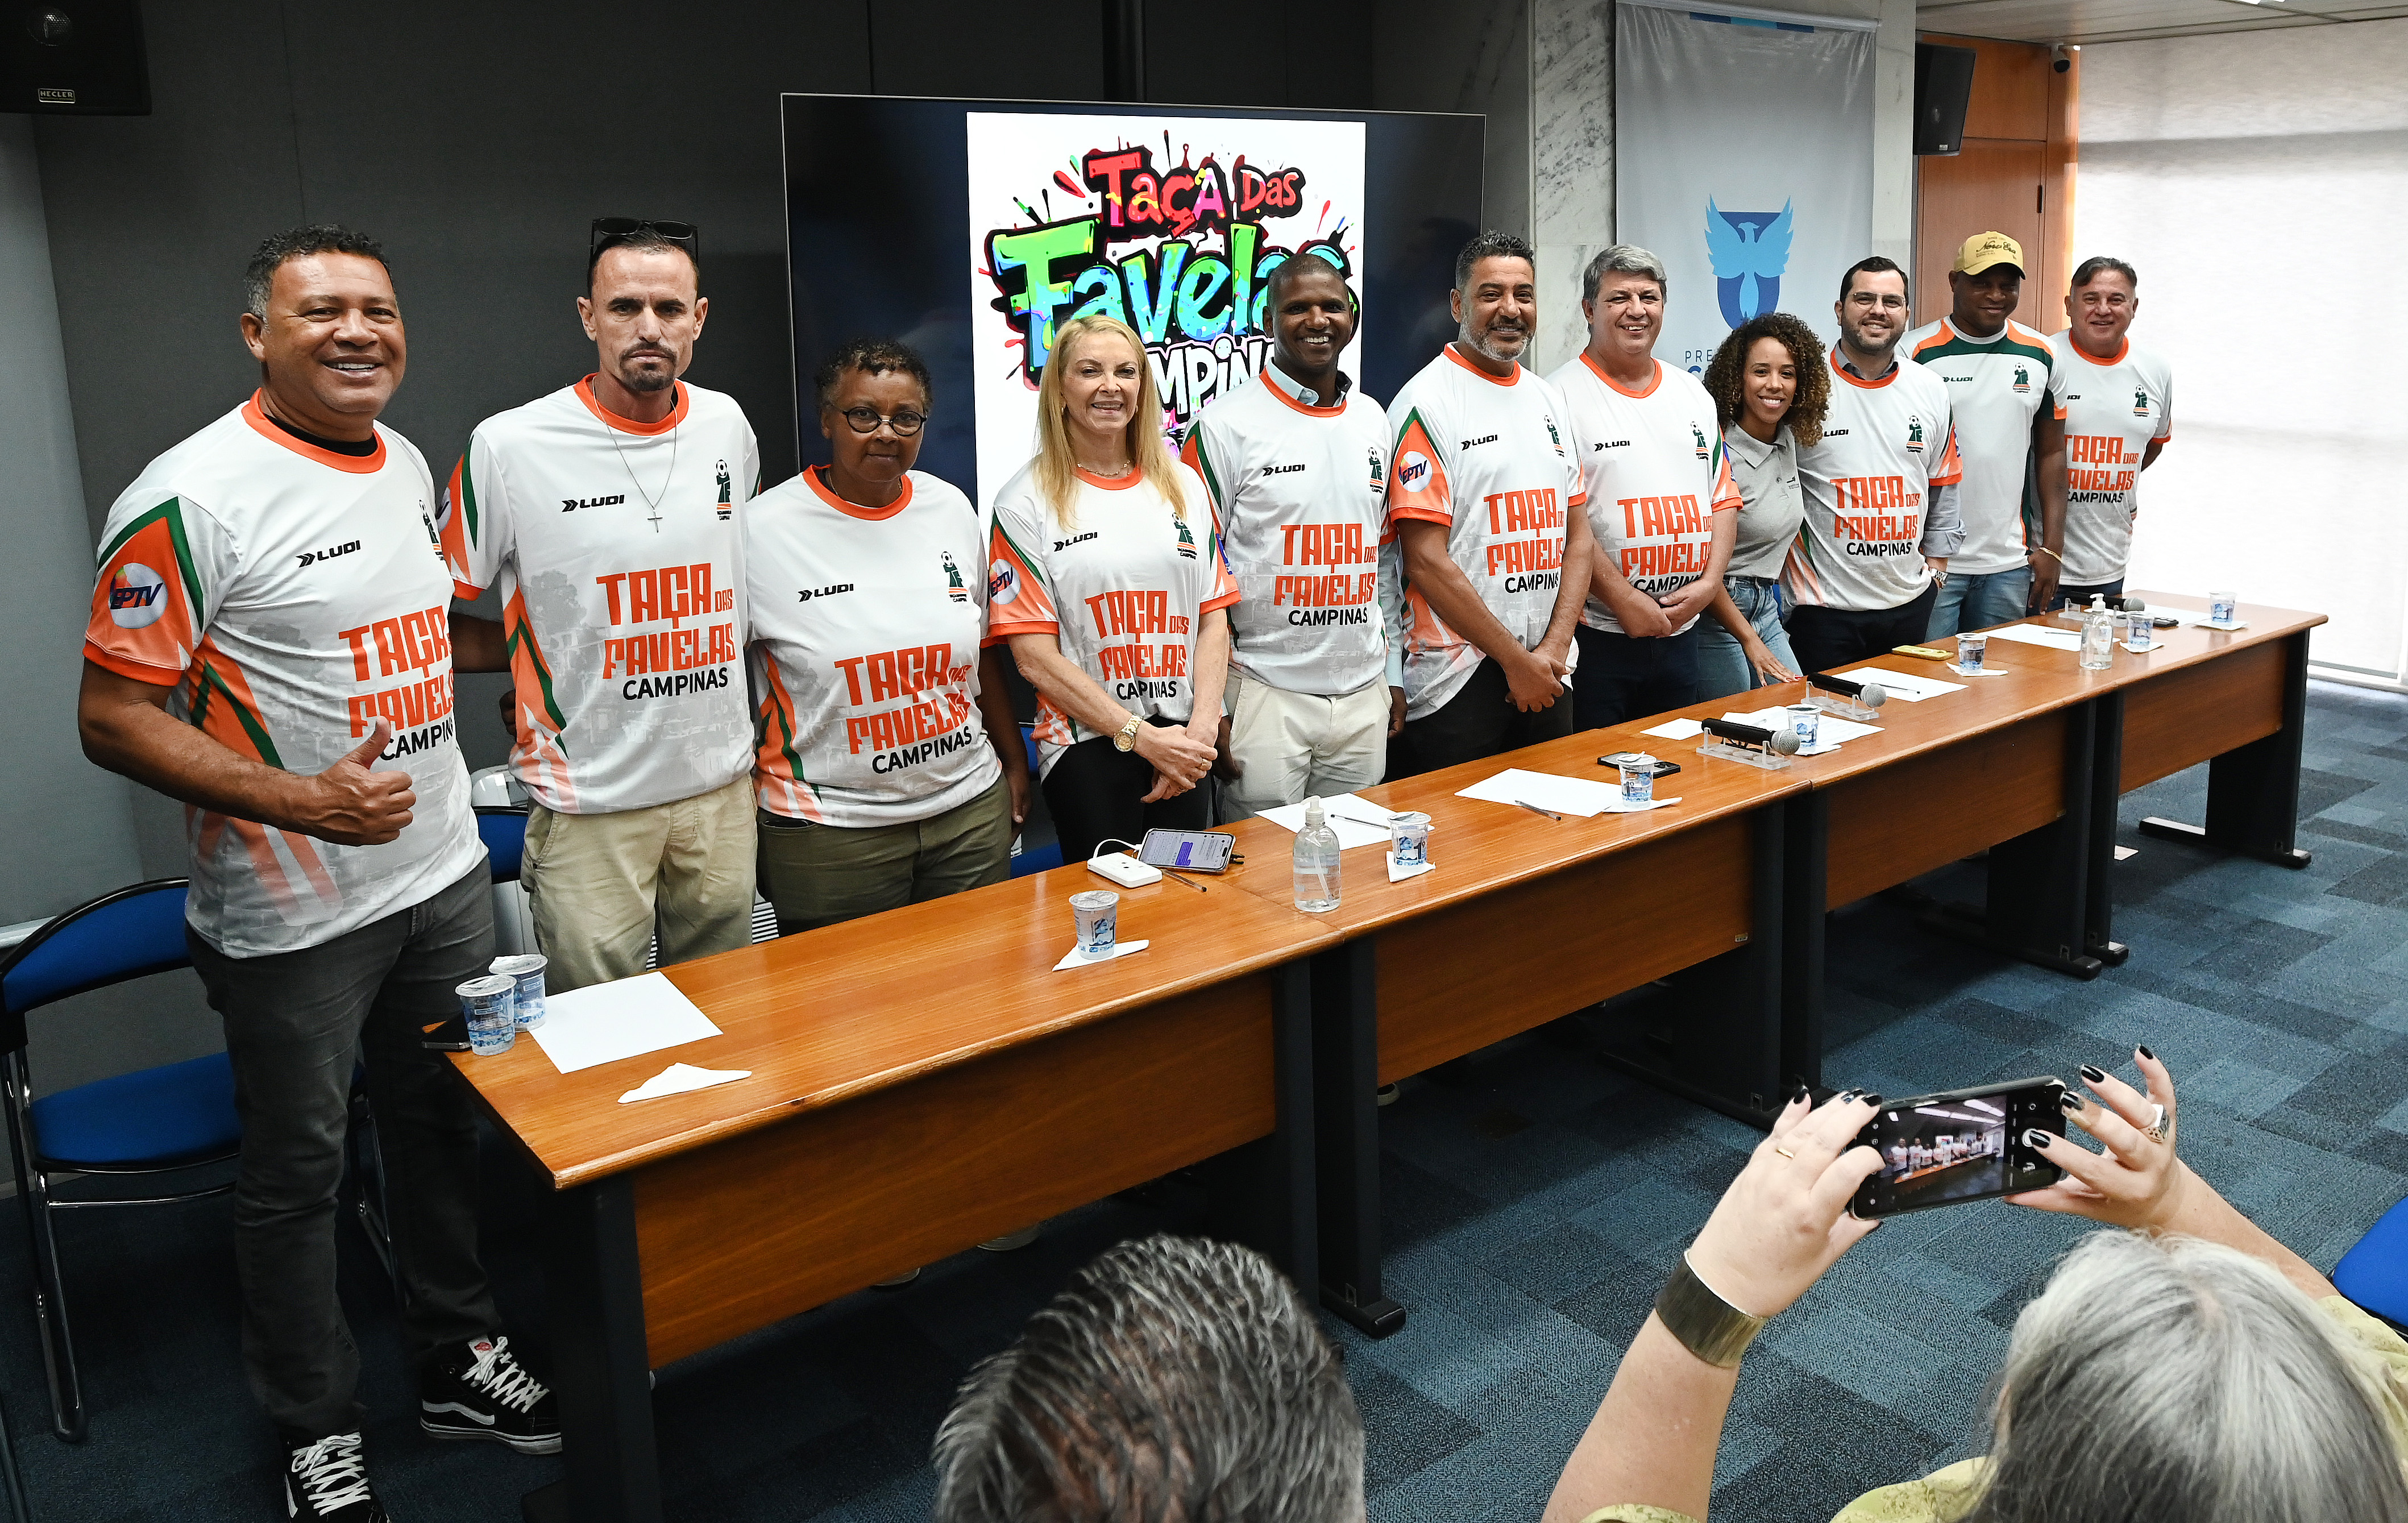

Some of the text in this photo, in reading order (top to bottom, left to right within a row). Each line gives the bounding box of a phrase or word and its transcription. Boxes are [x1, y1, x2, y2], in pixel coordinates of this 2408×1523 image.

[993, 219, 1358, 371] Favel
[1472, 434, 1498, 446] LUDI
[1605, 441, 1630, 449] LUDI
[1824, 429, 1849, 437] LUDI
[1274, 464, 1305, 474] LUDI
[1402, 459, 1427, 485] EPTV
[2123, 453, 2139, 464] DAS
[2067, 468, 2135, 491] AVELAS
[579, 494, 625, 509] LUDI
[1830, 475, 1904, 515] TAÇA
[1905, 493, 1920, 507] DAS
[2068, 491, 2124, 504] AMPINAS
[1483, 488, 1557, 538] TAÇA
[1617, 494, 1702, 542] TAÇA
[1834, 514, 1918, 541] FAVELAS
[317, 540, 360, 562] LUDI
[1065, 532, 1098, 547] LUDI
[1280, 523, 1377, 574] TAÇA DAS
[1846, 542, 1912, 557] CAMPINAS
[110, 582, 164, 610] EPTV
[596, 562, 733, 629] TAÇA DAS
[814, 583, 854, 597] LUDI
[990, 566, 1014, 598] EPTV
[1273, 572, 1376, 607] FAVELAS
[1084, 590, 1189, 644] TAÇA DAS
[1288, 607, 1368, 626] CAMPINAS
[338, 605, 449, 682] TAÇA
[602, 623, 736, 679] FAVELAS
[623, 667, 729, 700] CAMPINAS
[833, 642, 972, 707] TAÇA DAS
[347, 667, 454, 738] FAVEL
[846, 690, 971, 755] FAVELAS
[871, 726, 973, 775] CAMPINAS
